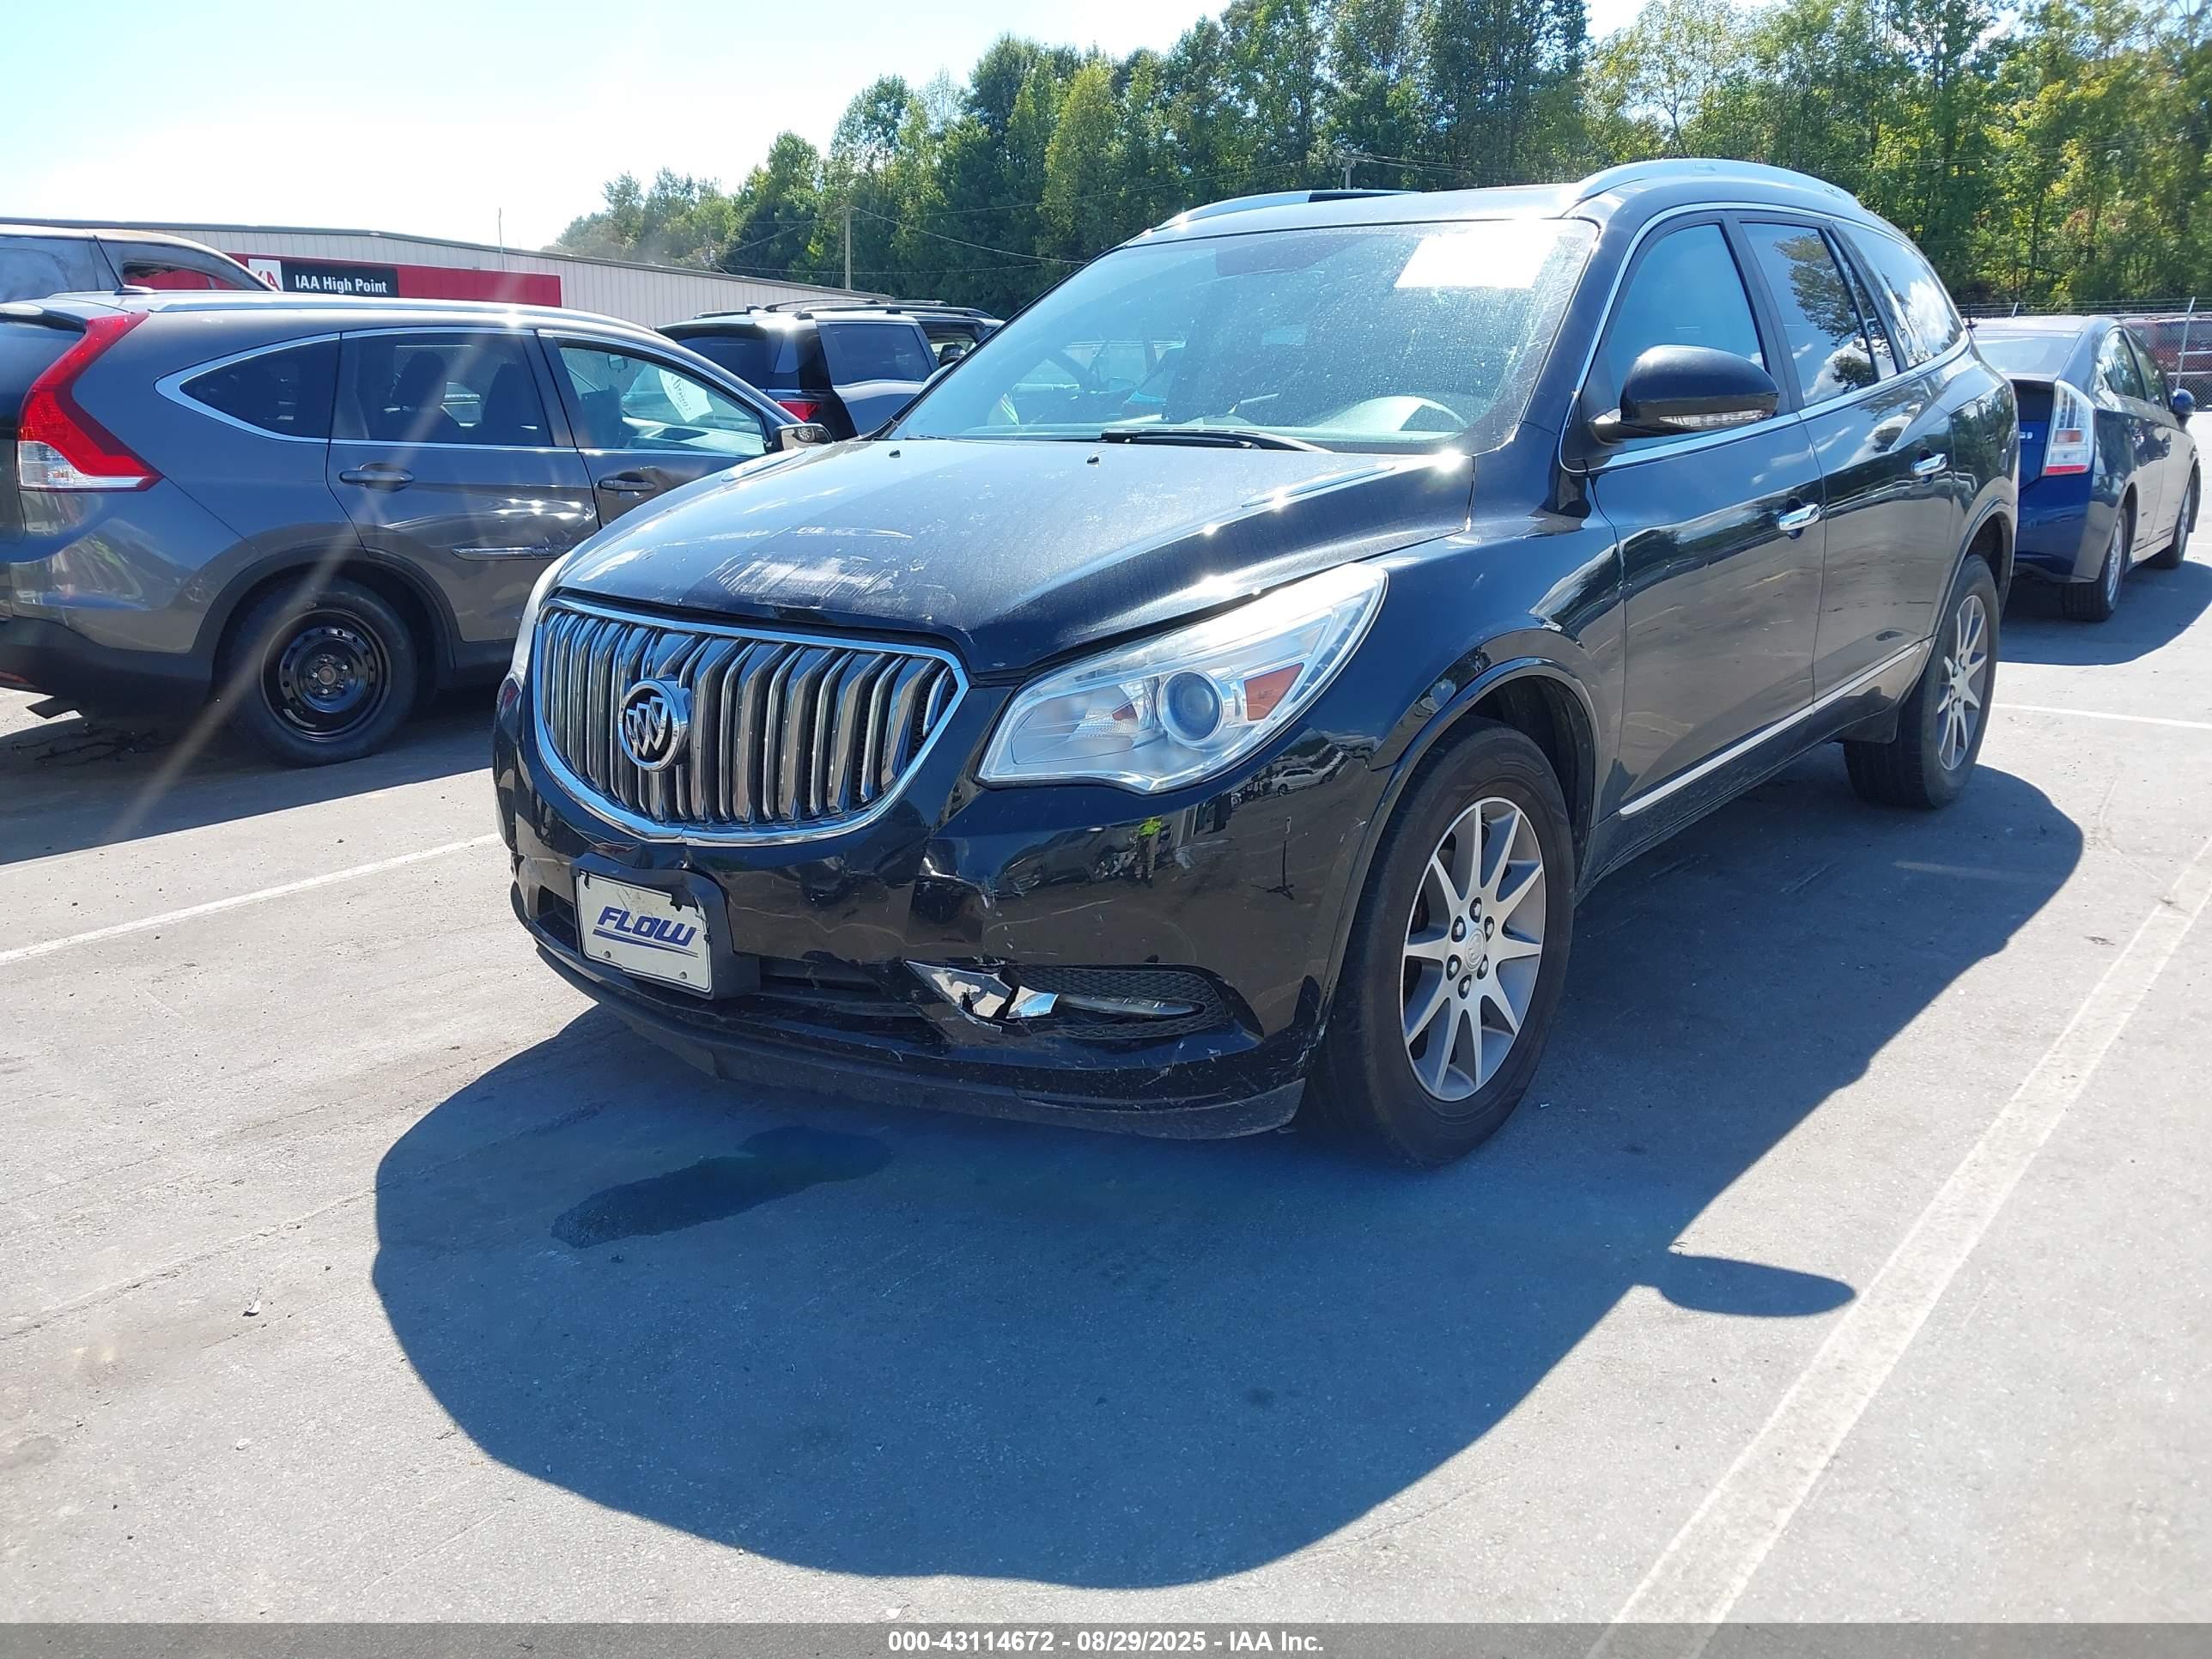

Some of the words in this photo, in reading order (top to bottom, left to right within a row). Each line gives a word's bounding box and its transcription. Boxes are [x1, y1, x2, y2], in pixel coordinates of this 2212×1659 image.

[295, 274, 320, 290] IAA
[323, 276, 352, 294] High
[355, 278, 387, 293] Point
[597, 906, 697, 947] FLOW
